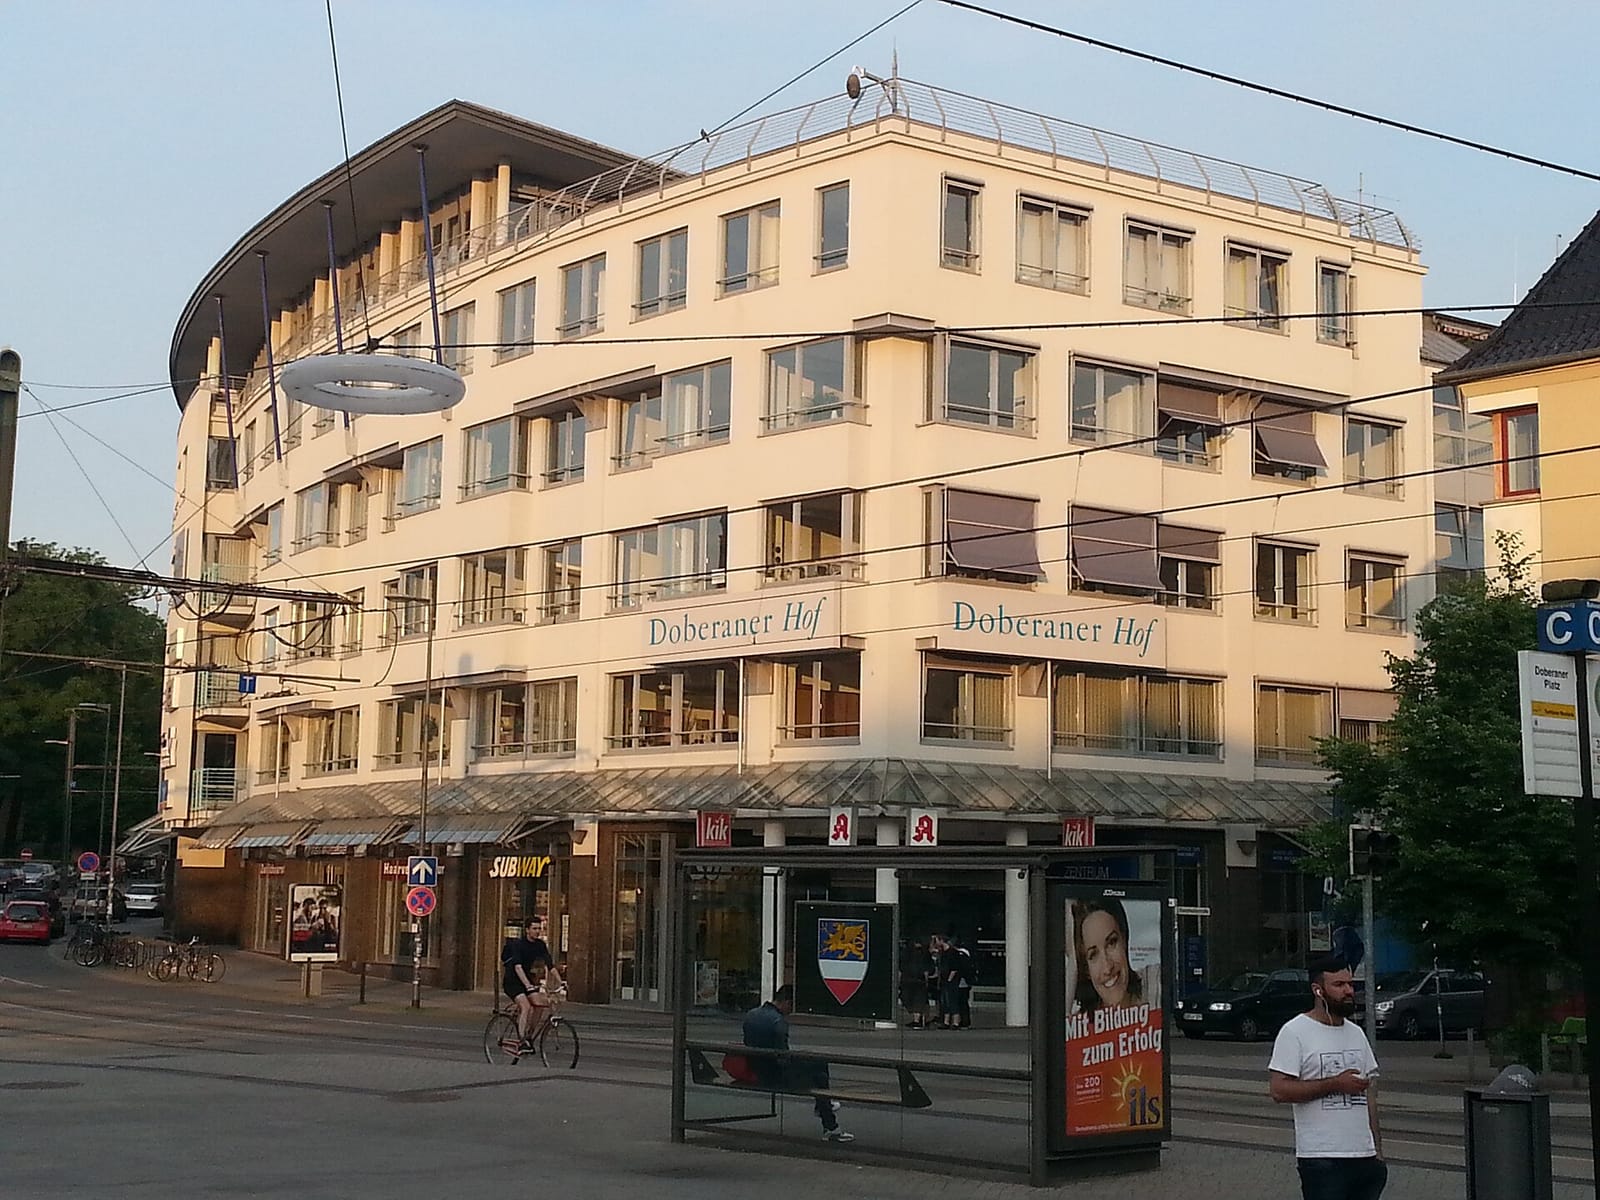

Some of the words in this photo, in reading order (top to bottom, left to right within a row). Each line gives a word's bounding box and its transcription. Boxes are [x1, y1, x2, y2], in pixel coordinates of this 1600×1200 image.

[650, 613, 773, 646] Doberaner
[783, 596, 827, 640] Hof
[952, 601, 1102, 642] Doberaner
[1112, 616, 1158, 658] Hof
[1546, 610, 1573, 645] C
[243, 676, 254, 692] T
[1534, 665, 1569, 679] Doberaner
[1544, 679, 1561, 691] Platz
[488, 855, 551, 878] SUBWAY
[1065, 1012, 1090, 1042] Mit
[1094, 1002, 1150, 1035] Bildung
[1082, 1041, 1114, 1067] zum
[1119, 1026, 1162, 1057] Erfolg
[1085, 1076, 1101, 1088] 200
[1129, 1085, 1161, 1127] ils
